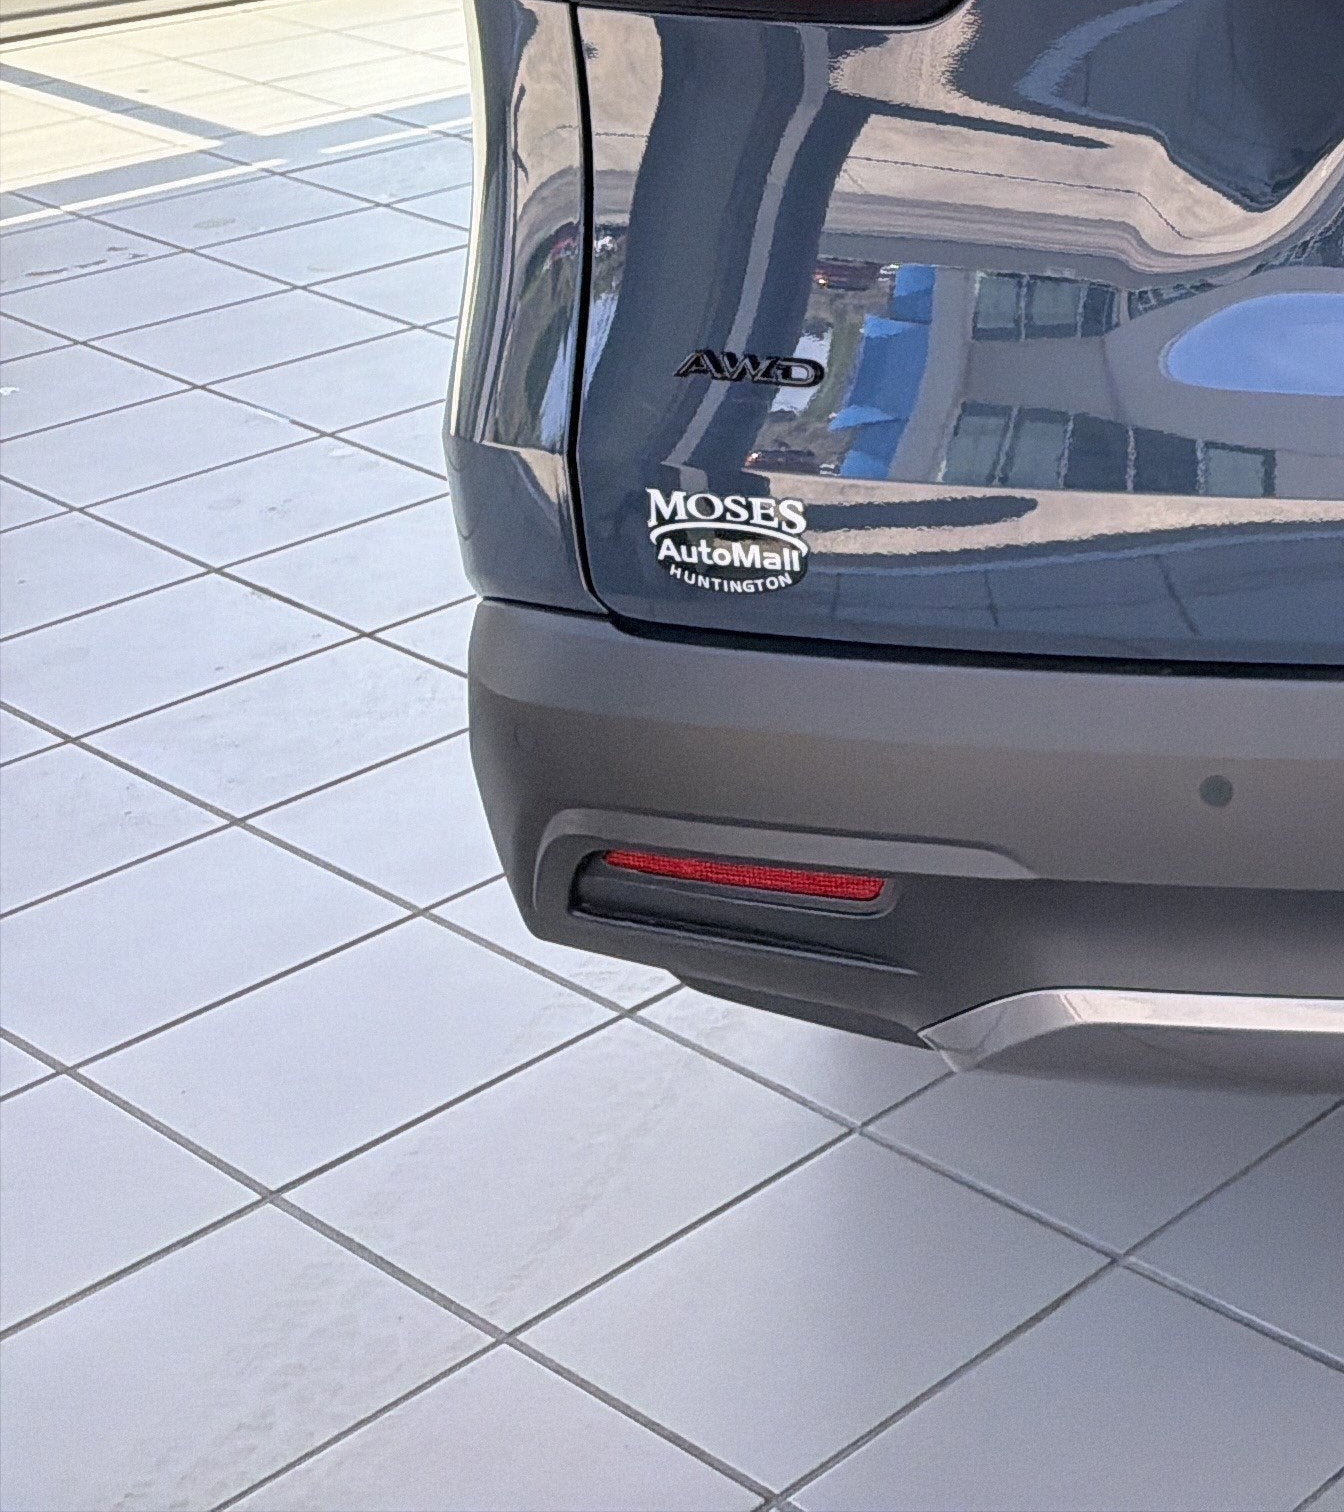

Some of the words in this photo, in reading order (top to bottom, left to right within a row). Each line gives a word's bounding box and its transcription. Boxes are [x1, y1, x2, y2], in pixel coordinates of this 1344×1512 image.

[673, 349, 825, 388] AWD
[645, 487, 807, 535] MOSES
[657, 538, 801, 572] AutoMall
[669, 563, 793, 593] HUNTINGTON
